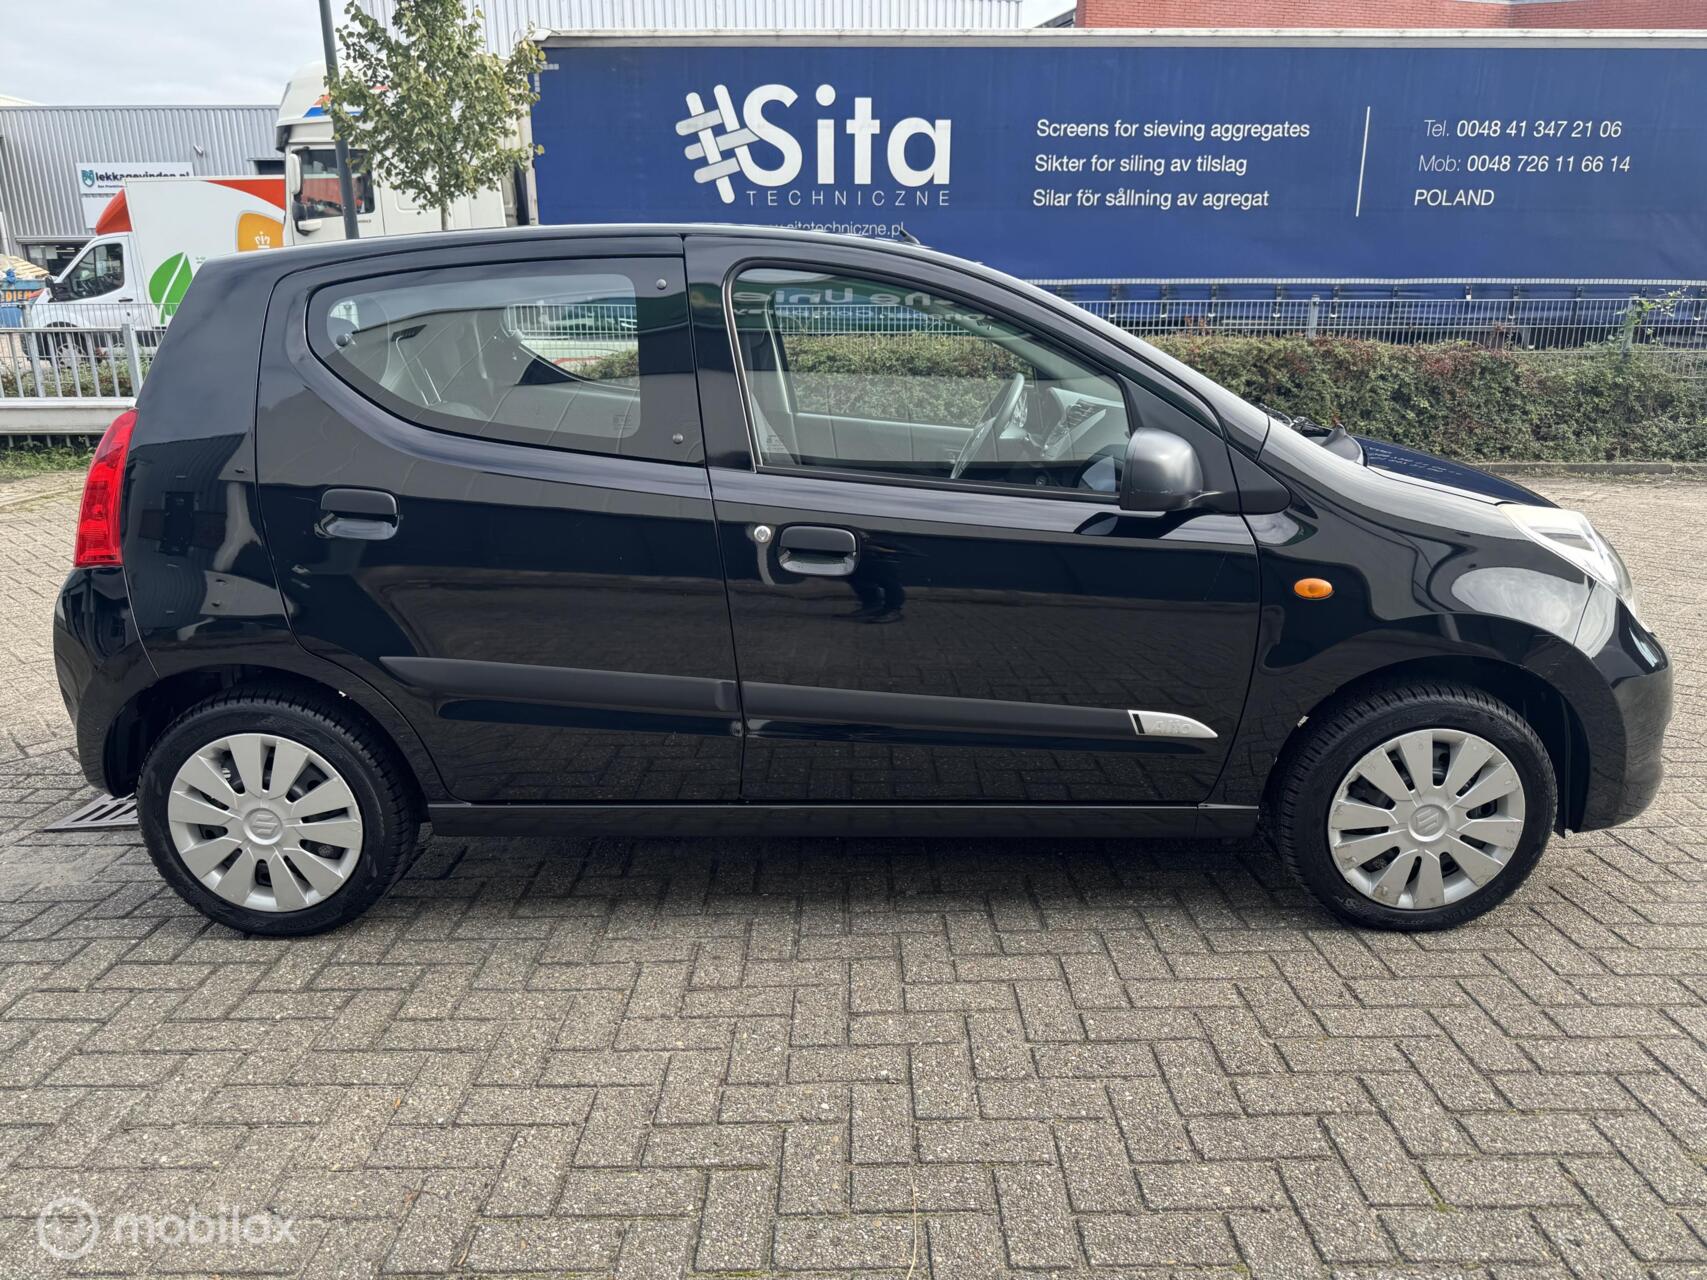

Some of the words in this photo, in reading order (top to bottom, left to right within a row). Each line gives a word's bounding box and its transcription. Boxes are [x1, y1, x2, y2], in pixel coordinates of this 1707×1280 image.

[735, 84, 952, 187] Sita
[1036, 118, 1109, 137] Screens
[1114, 119, 1140, 137] for
[1143, 119, 1206, 142] sieving
[1210, 120, 1310, 142] aggregates
[1424, 119, 1450, 137] Tel.
[1456, 119, 1502, 138] 0048
[1505, 120, 1527, 137] 41
[1533, 120, 1568, 138] 347
[1571, 120, 1593, 138] 21
[1599, 120, 1623, 138] 06
[1034, 153, 1087, 172] Sikter
[1090, 154, 1116, 172] for
[1119, 154, 1166, 176] siling
[1170, 158, 1192, 172] av
[1196, 154, 1248, 176] tilslag
[1418, 154, 1461, 172] Mob:
[1466, 154, 1511, 172] 0048
[1517, 155, 1550, 173] 726
[1555, 155, 1575, 172] 11
[1581, 155, 1604, 173] 66
[1610, 155, 1631, 173] 14
[746, 189, 950, 206] TECHNICZNE
[1032, 188, 1073, 207] Silar
[1076, 189, 1102, 207] för
[1105, 187, 1172, 211] sållning
[1176, 193, 1198, 207] av
[1202, 190, 1270, 211] agregat
[1414, 188, 1495, 207] POLAND
